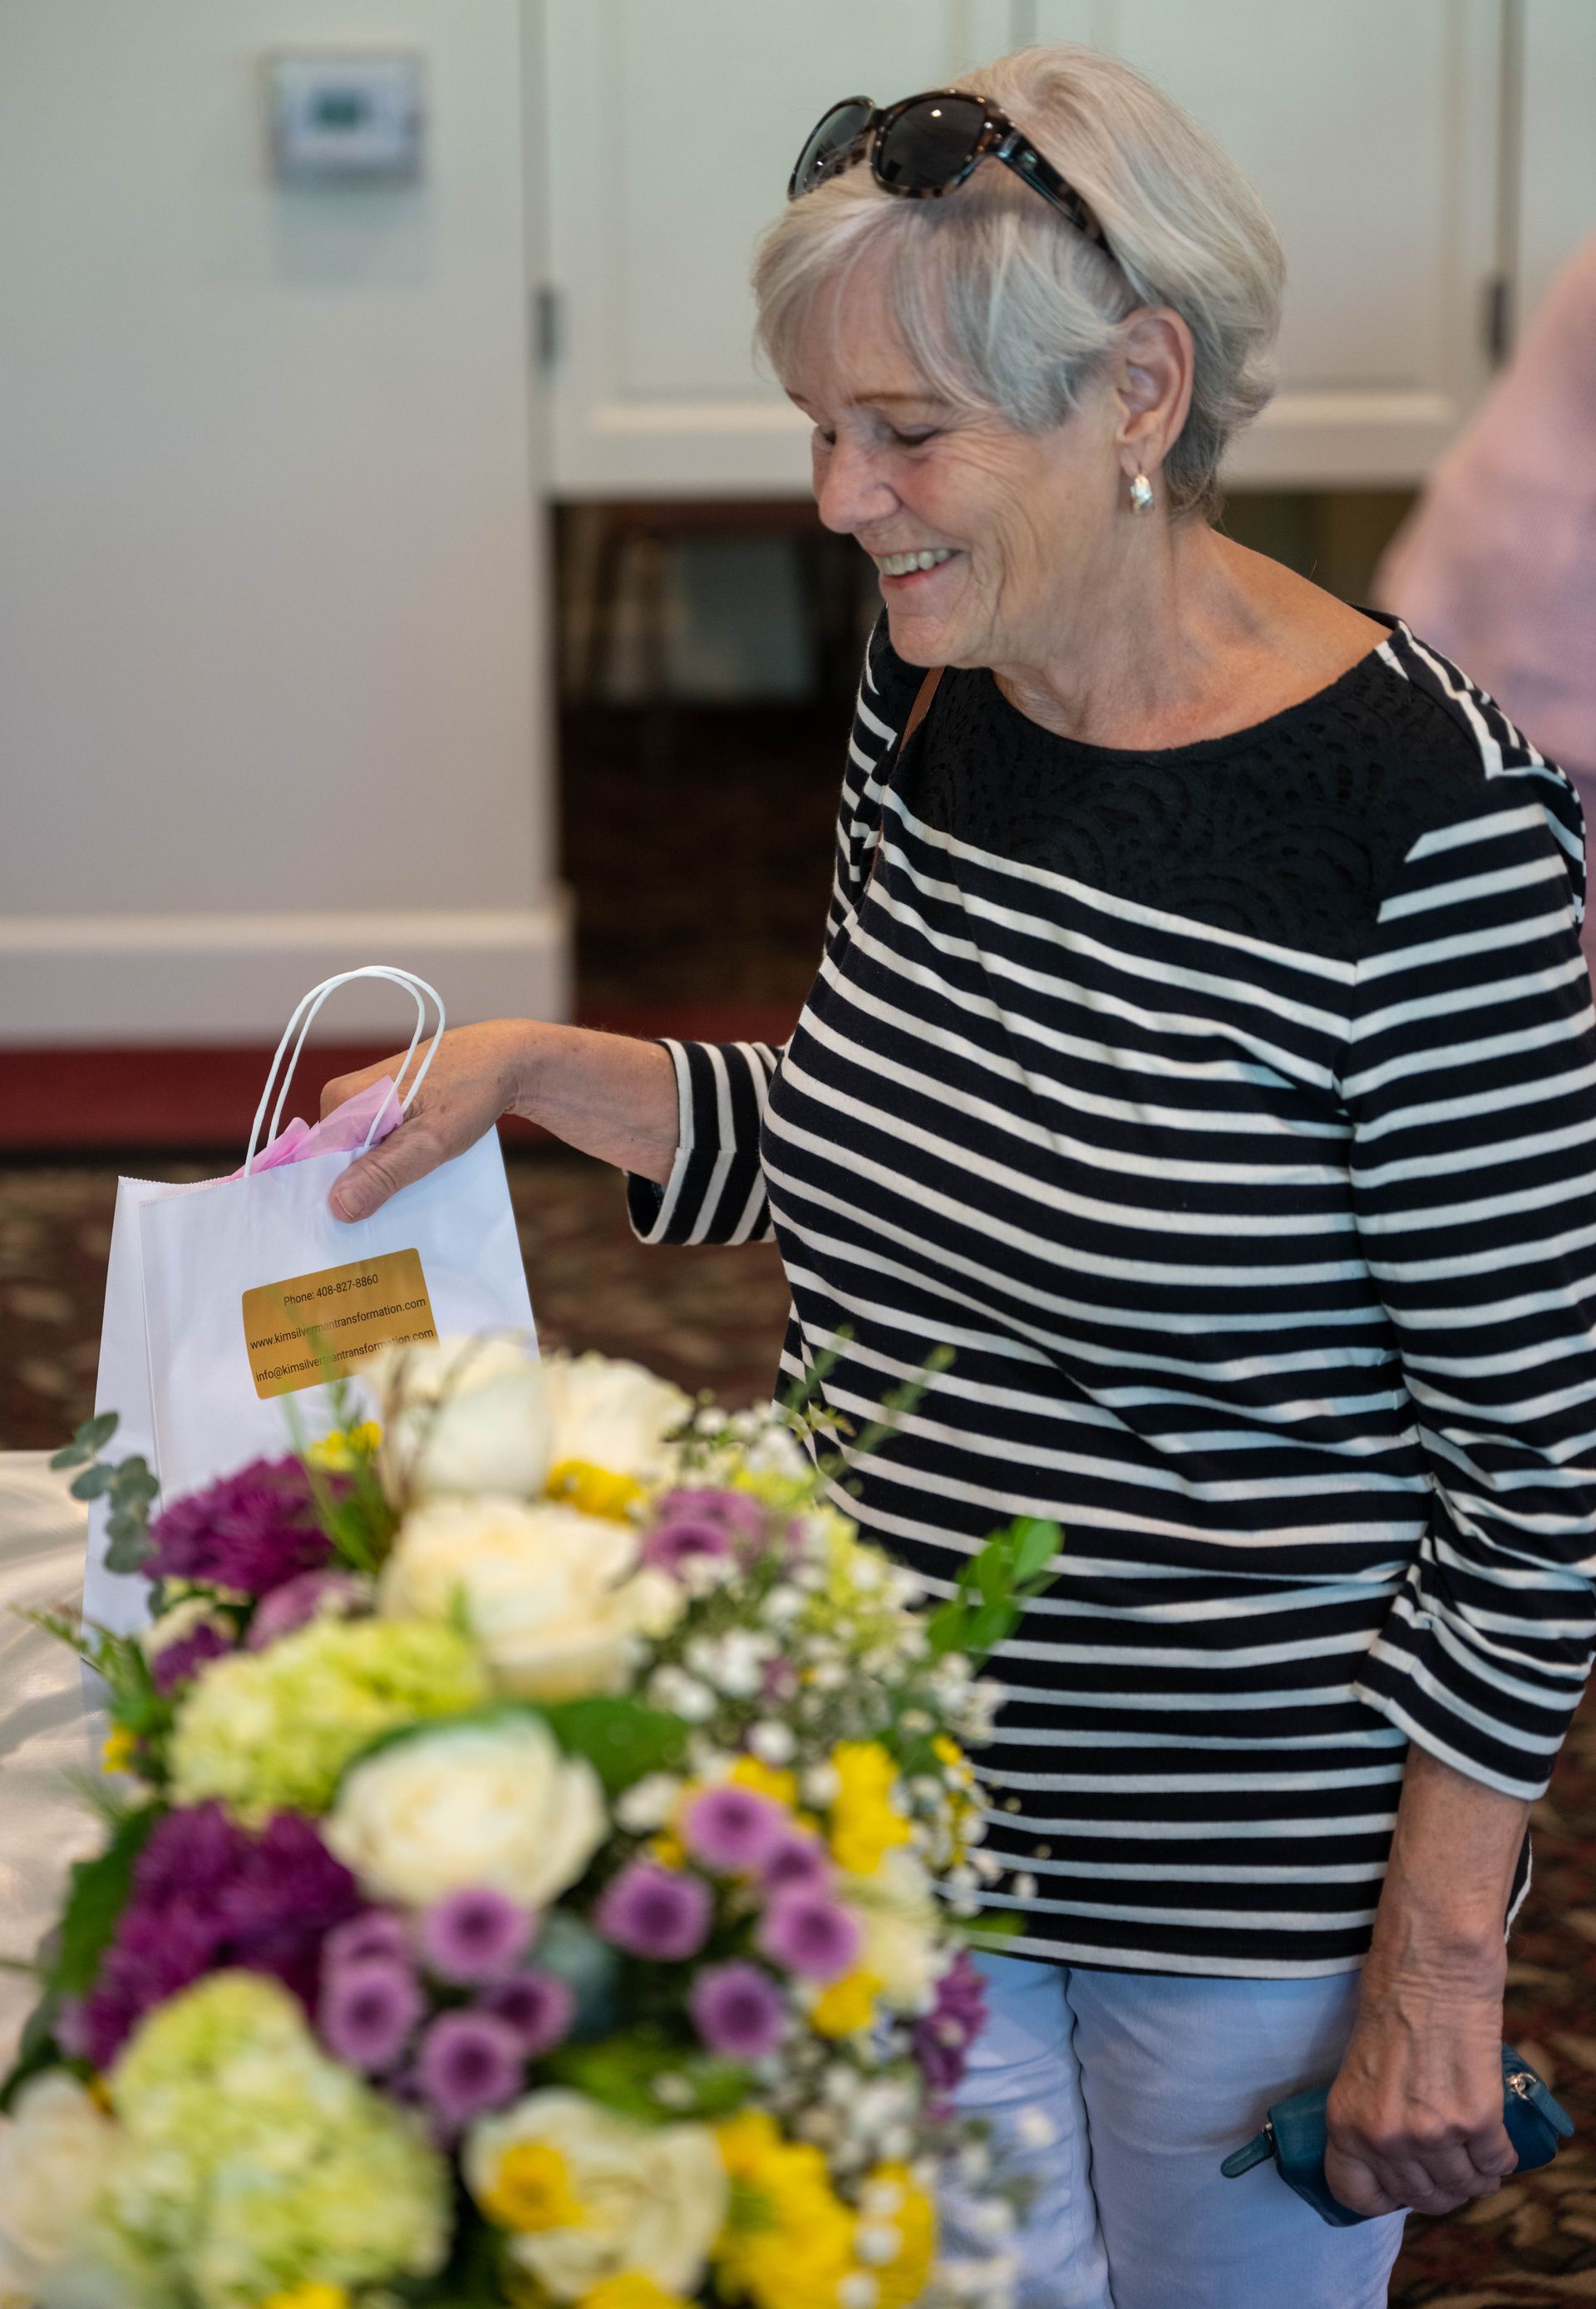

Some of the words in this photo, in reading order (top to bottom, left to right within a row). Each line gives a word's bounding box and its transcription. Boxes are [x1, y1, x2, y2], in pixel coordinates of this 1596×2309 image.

[283, 1290, 315, 1307] Phone:
[316, 1273, 379, 1297] 408-827-8860
[249, 1297, 426, 1350] www.kimsilvermantransformation.com
